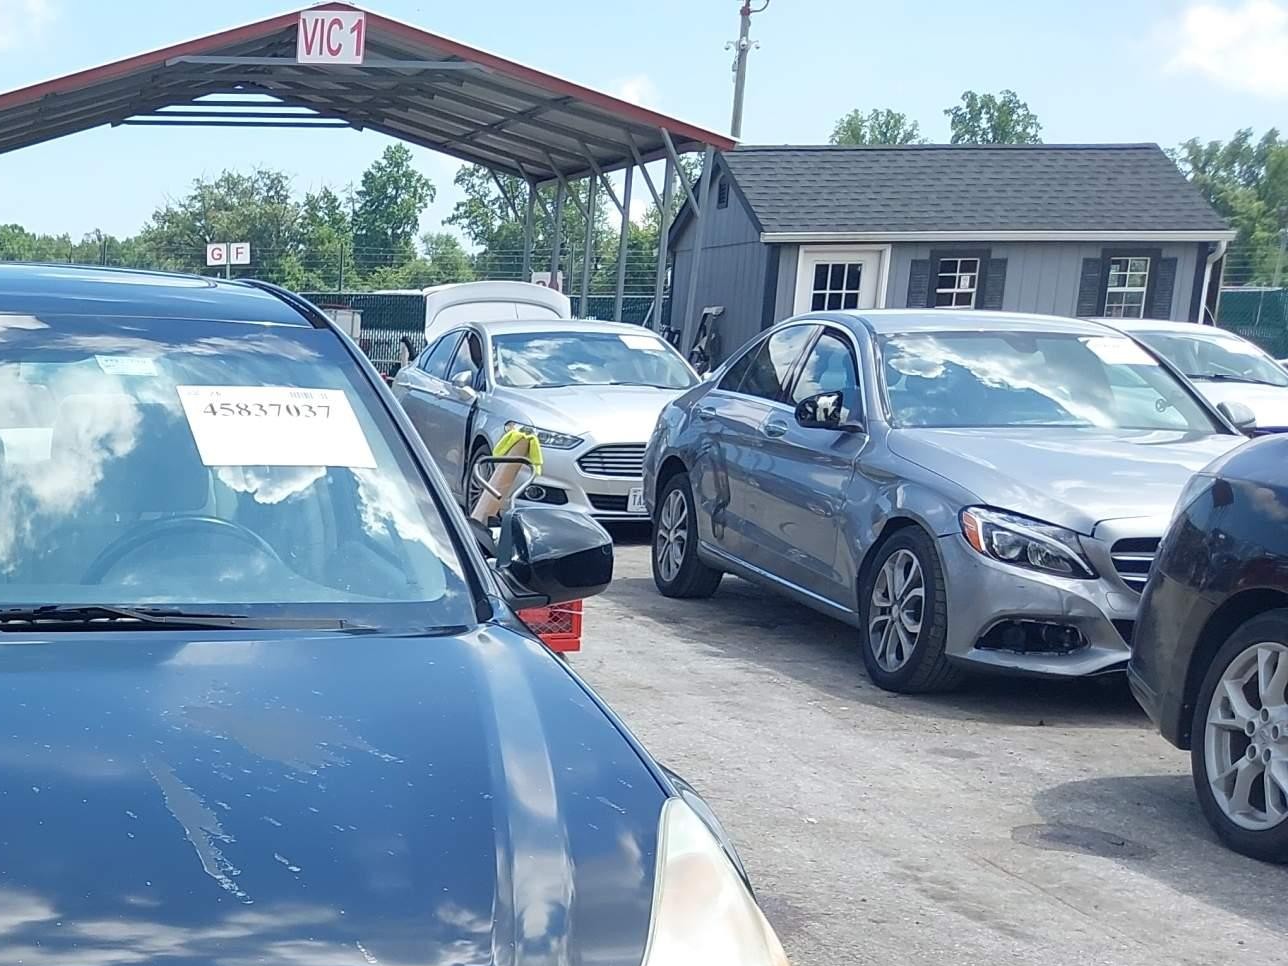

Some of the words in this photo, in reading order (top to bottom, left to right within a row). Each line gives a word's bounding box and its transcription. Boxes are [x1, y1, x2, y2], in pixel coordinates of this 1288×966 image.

[302, 18, 343, 56] VIC
[350, 19, 363, 56] 1
[211, 247, 222, 261] G
[235, 246, 244, 260] F
[203, 402, 330, 418] 45837037
